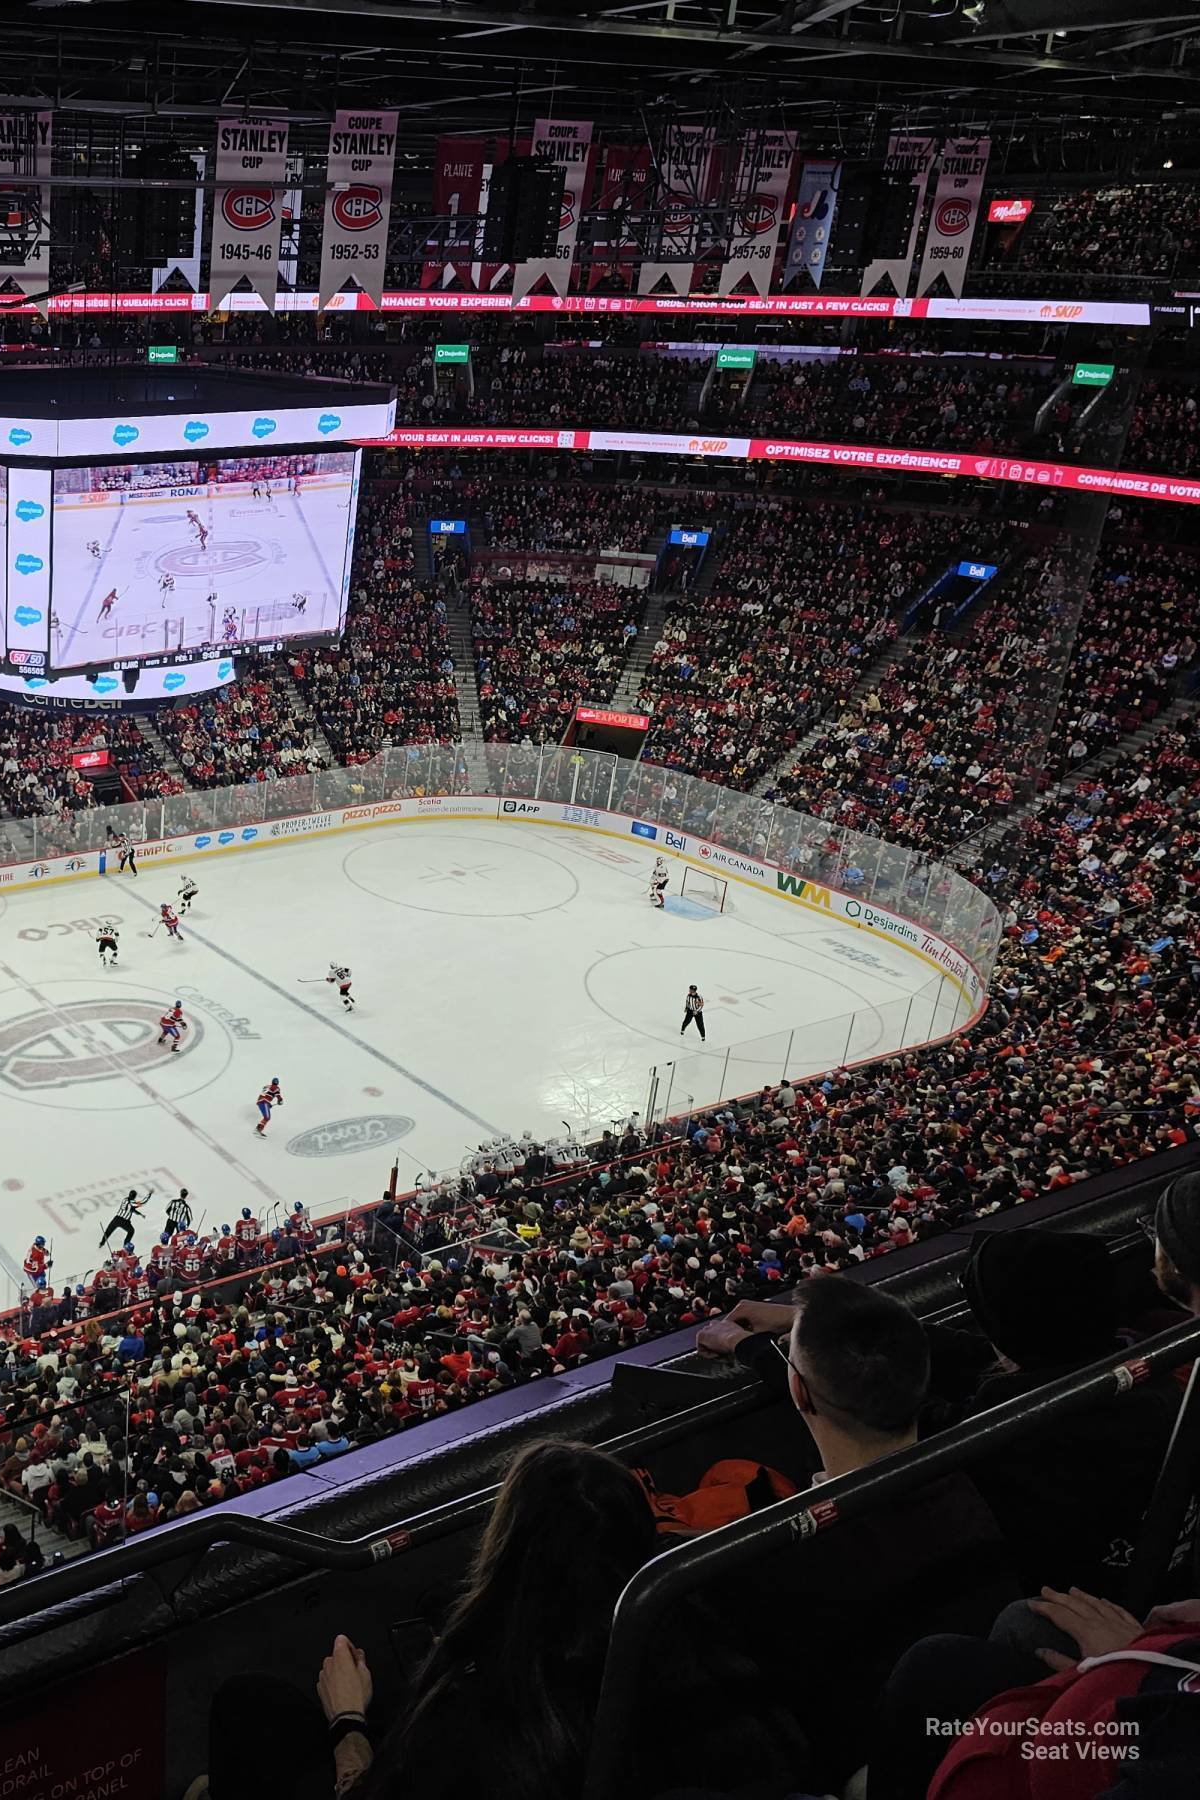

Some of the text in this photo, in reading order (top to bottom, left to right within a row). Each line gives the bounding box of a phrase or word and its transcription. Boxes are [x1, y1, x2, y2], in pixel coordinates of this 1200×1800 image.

[347, 116, 382, 131] COUPE
[548, 125, 579, 139] COUPE
[221, 128, 287, 153] STANLEY
[332, 133, 395, 156] STANLEY
[242, 156, 263, 170] CUP
[351, 159, 373, 172] CUP
[743, 149, 793, 169] STANLEY
[943, 157, 987, 175] STANLEY
[443, 163, 474, 178] PLANTE
[756, 171, 773, 183] CUP
[953, 178, 969, 188] CUP
[992, 206, 1028, 219] Molson
[219, 243, 272, 261] 1945-46
[329, 243, 380, 260] 1952-53
[732, 245, 771, 259] 1957-58
[929, 247, 964, 259] 1959-60
[86, 297, 189, 309] SIÈGE QUELQUES CLICS!
[381, 297, 459, 307] NHANCE YOUR
[749, 300, 774, 310] SEAT
[776, 301, 788, 310] IN
[789, 301, 815, 310] JUST
[816, 301, 824, 310] A
[825, 301, 850, 311] FEW
[851, 301, 889, 312] CLICKS!
[1054, 304, 1083, 318] SKIP
[726, 355, 751, 363] Desjardins
[1085, 370, 1111, 379] Desjardins
[400, 434, 554, 444] YOUR SEAT IN JUST A FEW CLICKS!
[699, 440, 728, 452] SKIP
[765, 444, 830, 459] OPTIMISEZ
[833, 449, 874, 463] VOTRE
[877, 452, 960, 470] EXPÉRIENCE!
[1077, 474, 1150, 491] COMMANDEZ
[1151, 484, 1167, 493] DE
[170, 487, 199, 497] RONA
[441, 522, 455, 532] Bell
[682, 533, 697, 543] Bell
[969, 566, 985, 577] Bell
[13, 654, 43, 664] 50/50
[121, 660, 139, 670] BLANC
[595, 710, 633, 723] EXPORT
[418, 798, 442, 806] Scotia
[342, 803, 401, 823] pizza pizza
[563, 805, 601, 827] IBM
[665, 831, 687, 852] Bell
[712, 852, 765, 878] AIR CANADA
[777, 872, 832, 908] WM
[102, 926, 116, 937] 57
[864, 909, 918, 943] Desjardins
[921, 934, 939, 960] Tim
[311, 1119, 388, 1155] Ford
[241, 1228, 255, 1241] 68
[185, 1258, 200, 1272] 56
[51, 1748, 144, 1800] ON TOP OF
